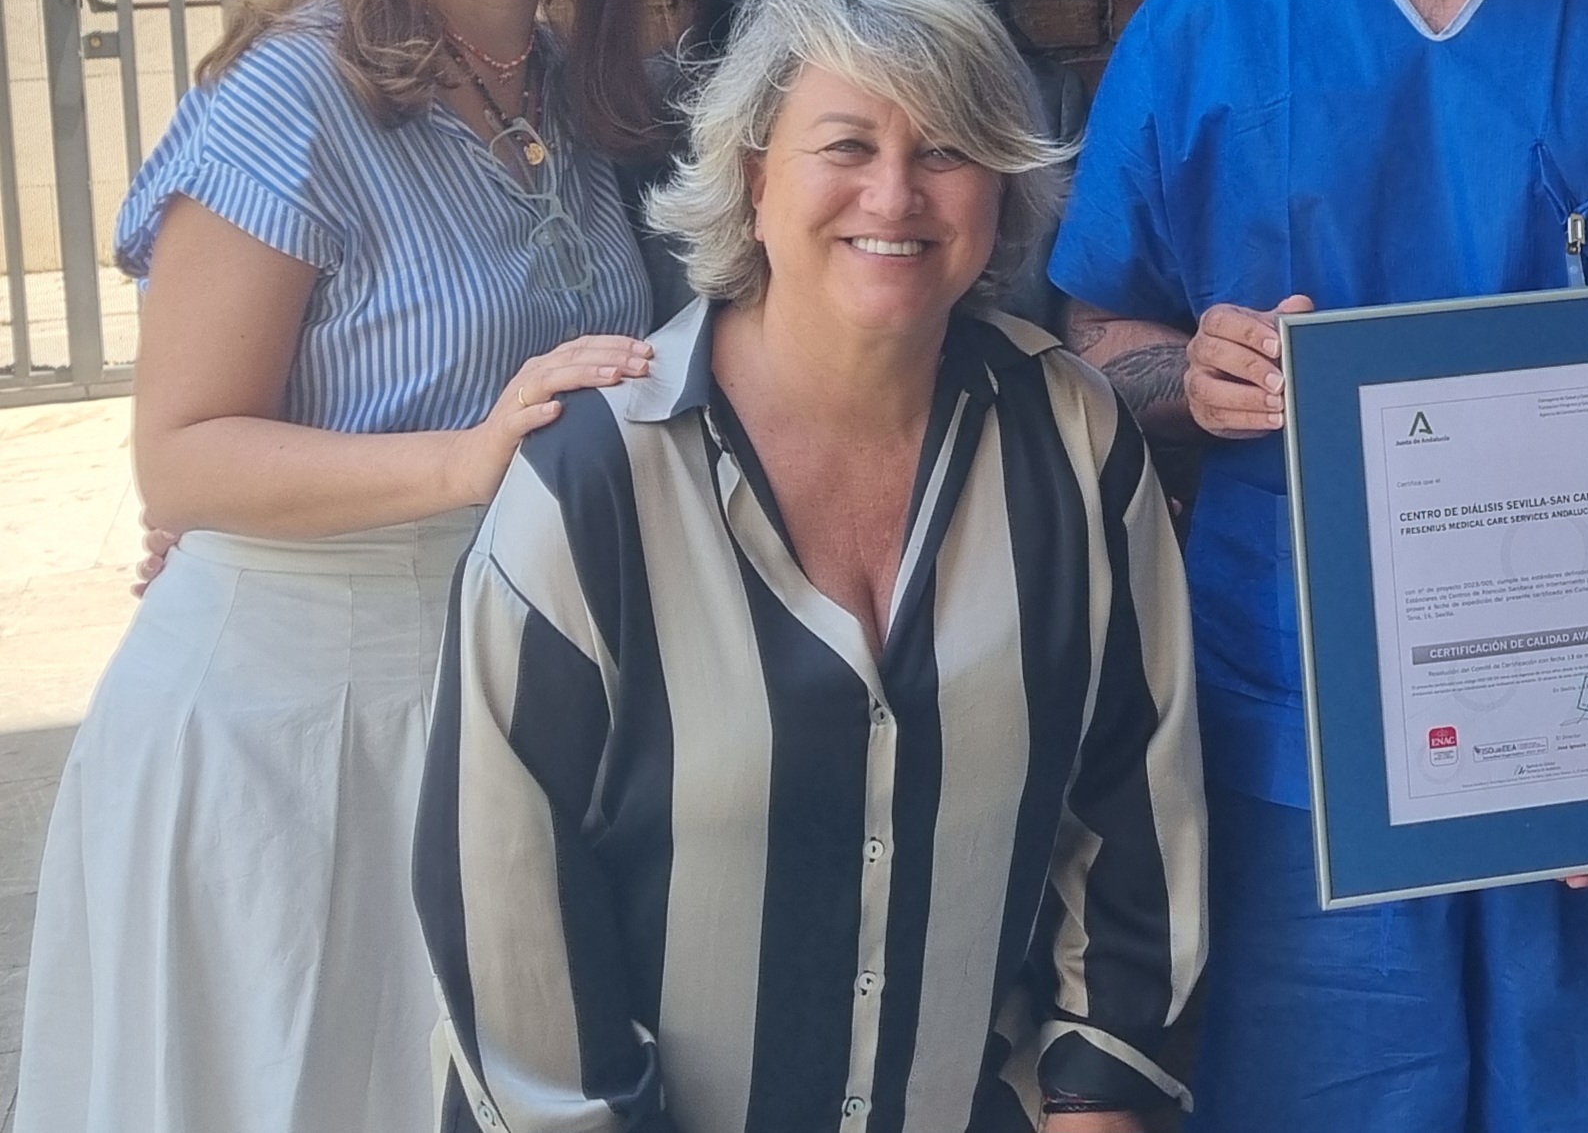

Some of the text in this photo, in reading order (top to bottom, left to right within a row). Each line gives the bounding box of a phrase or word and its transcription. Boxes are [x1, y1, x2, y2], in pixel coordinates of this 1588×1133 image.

[1400, 510, 1441, 522] CENTRO
[1445, 508, 1458, 517] DE
[1461, 501, 1503, 515] DIÁLISIS
[1507, 495, 1570, 510] SEVILLA-SAN
[1401, 524, 1446, 535] FRESENIUS
[1449, 520, 1484, 530] MEDICAL
[1487, 517, 1508, 526] CARE
[1511, 512, 1549, 523] SERVICES
[1429, 641, 1507, 658] CERTIFICACIÓN
[1510, 640, 1524, 649] DE
[1527, 635, 1569, 647] CALIDAD
[1432, 737, 1454, 746] ENAC
